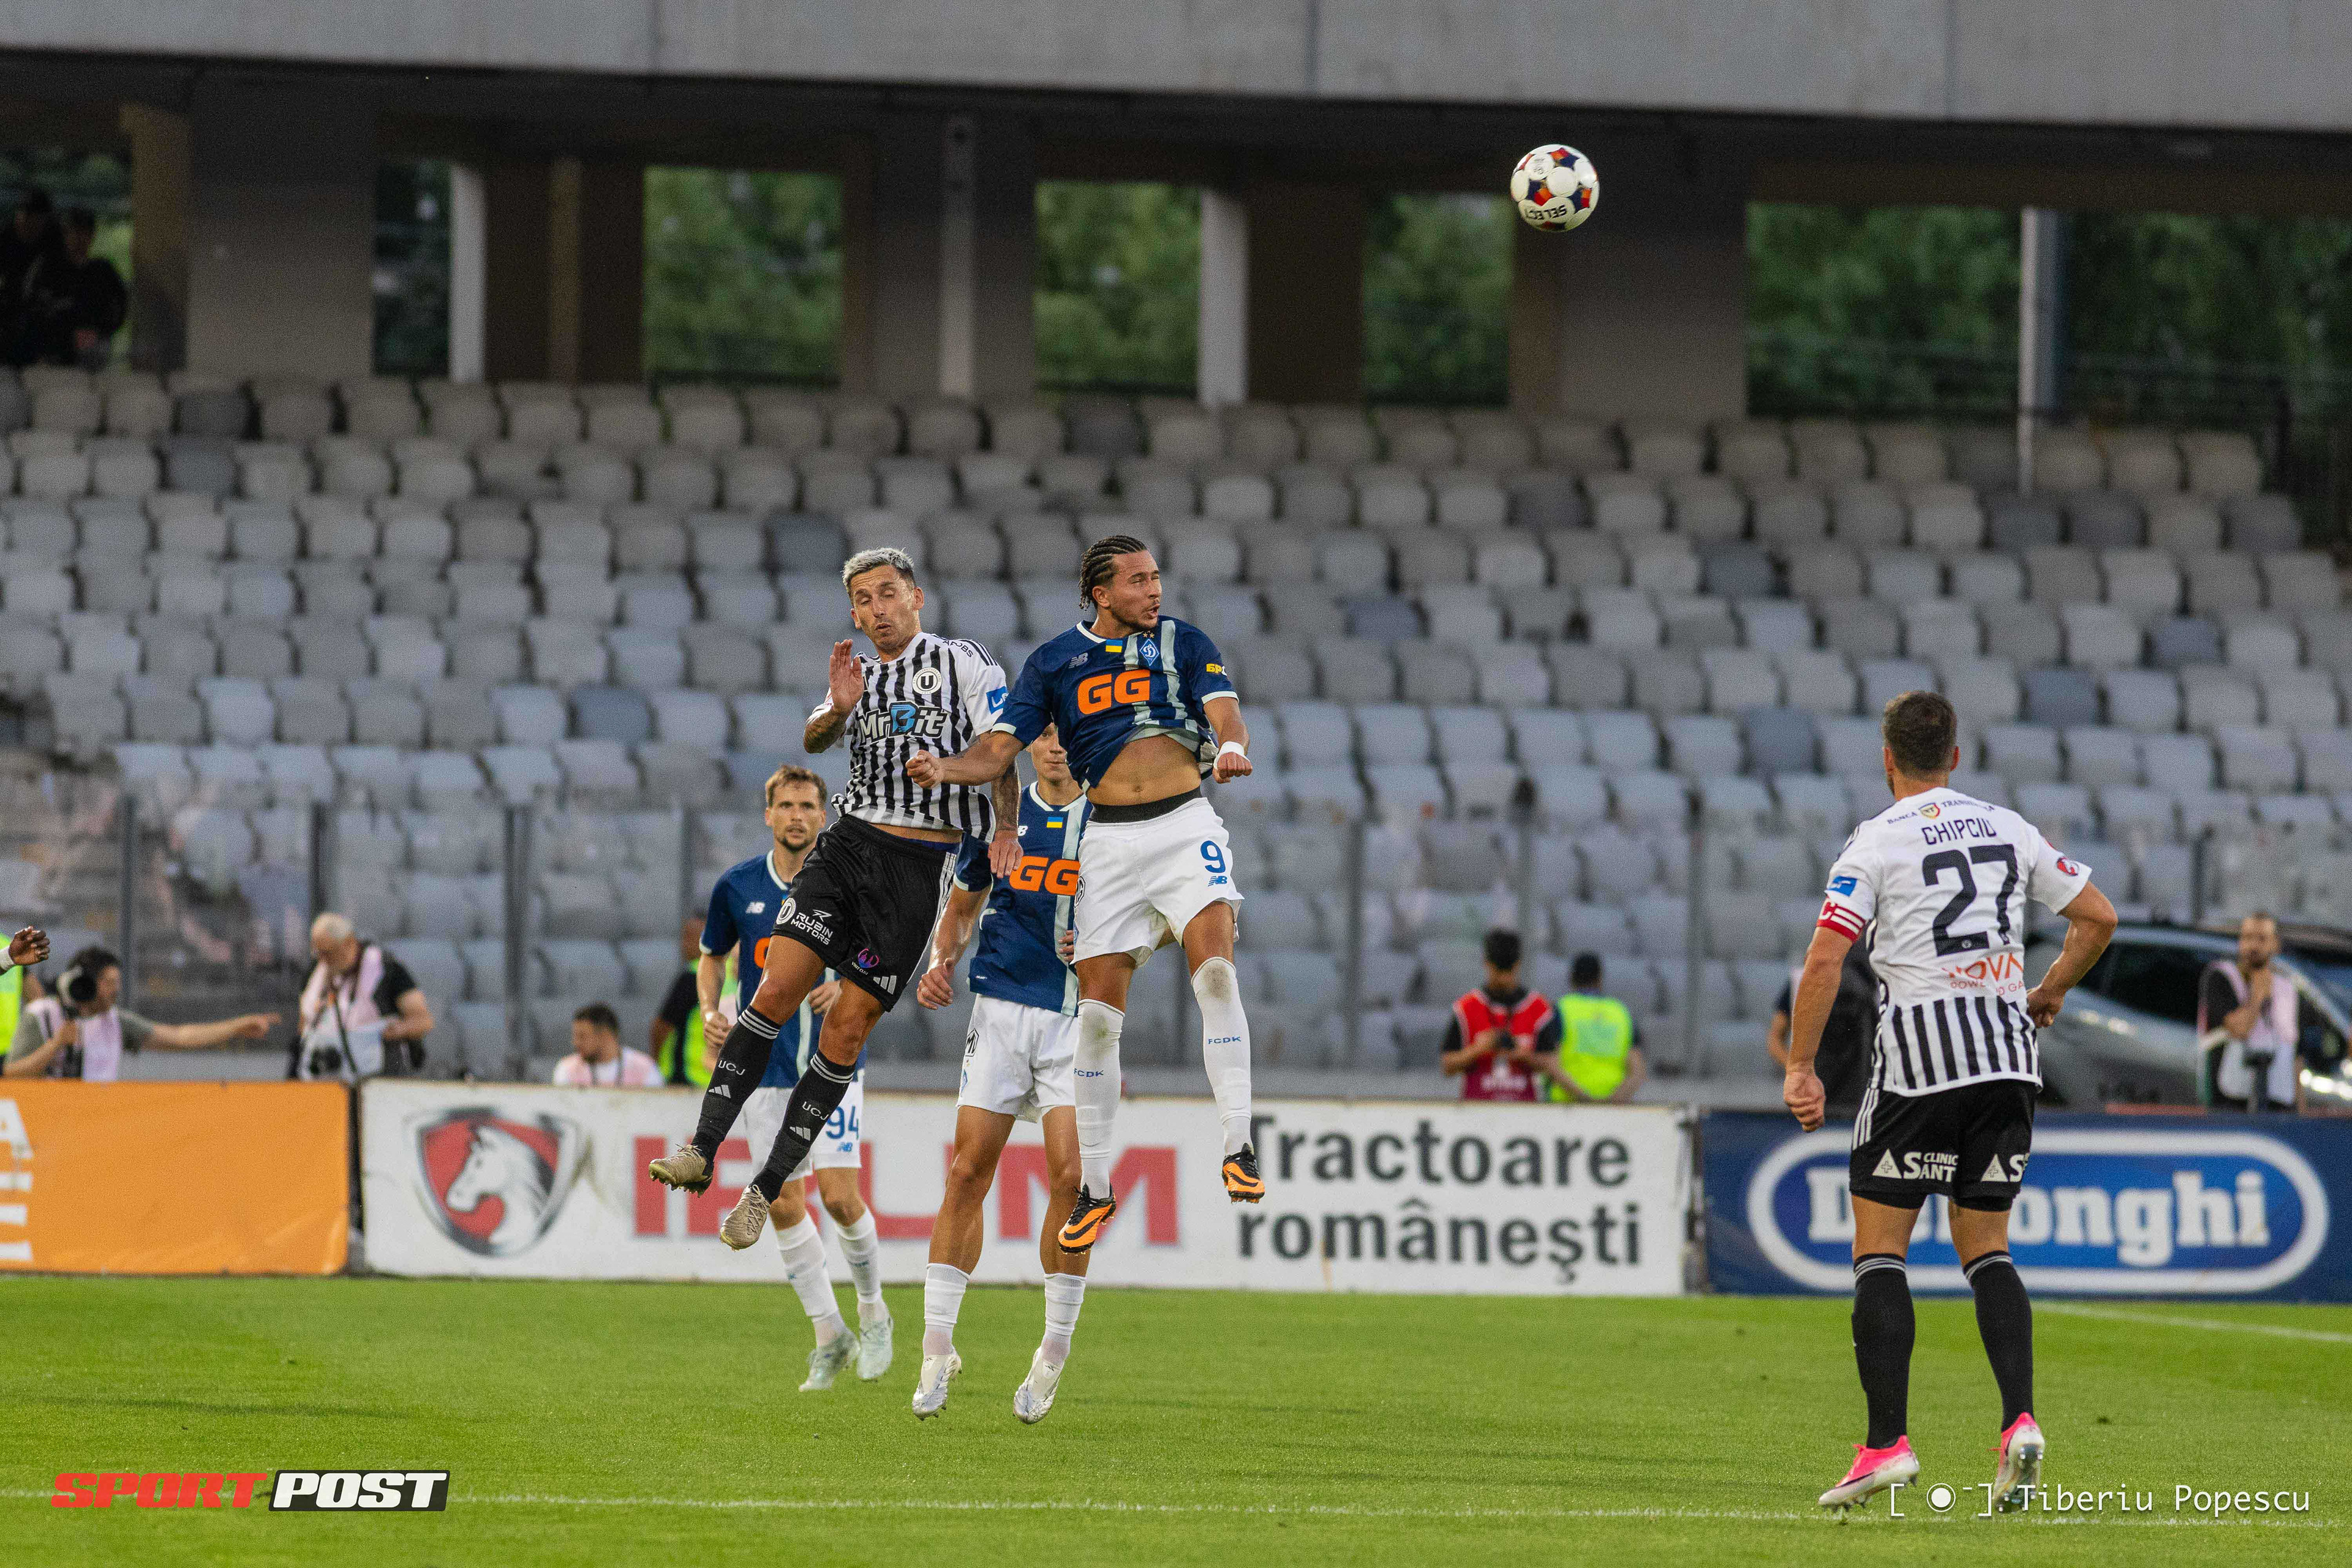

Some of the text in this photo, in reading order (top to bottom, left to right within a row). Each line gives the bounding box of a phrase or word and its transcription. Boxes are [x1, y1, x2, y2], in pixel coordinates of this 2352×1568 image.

[1077, 669, 1150, 715] GG
[858, 701, 946, 746] MrBit
[1921, 818, 1997, 845] CHIPCIU
[1200, 840, 1226, 873] 9
[1009, 855, 1081, 896] GG
[1922, 843, 2019, 957] 27
[790, 919, 831, 946] MOTORS
[796, 912, 834, 939] RUBIN
[1208, 1036, 1242, 1045] FCDK
[718, 1060, 745, 1076] UCJ
[802, 1101, 829, 1121] UCJ
[826, 1106, 859, 1140] 94
